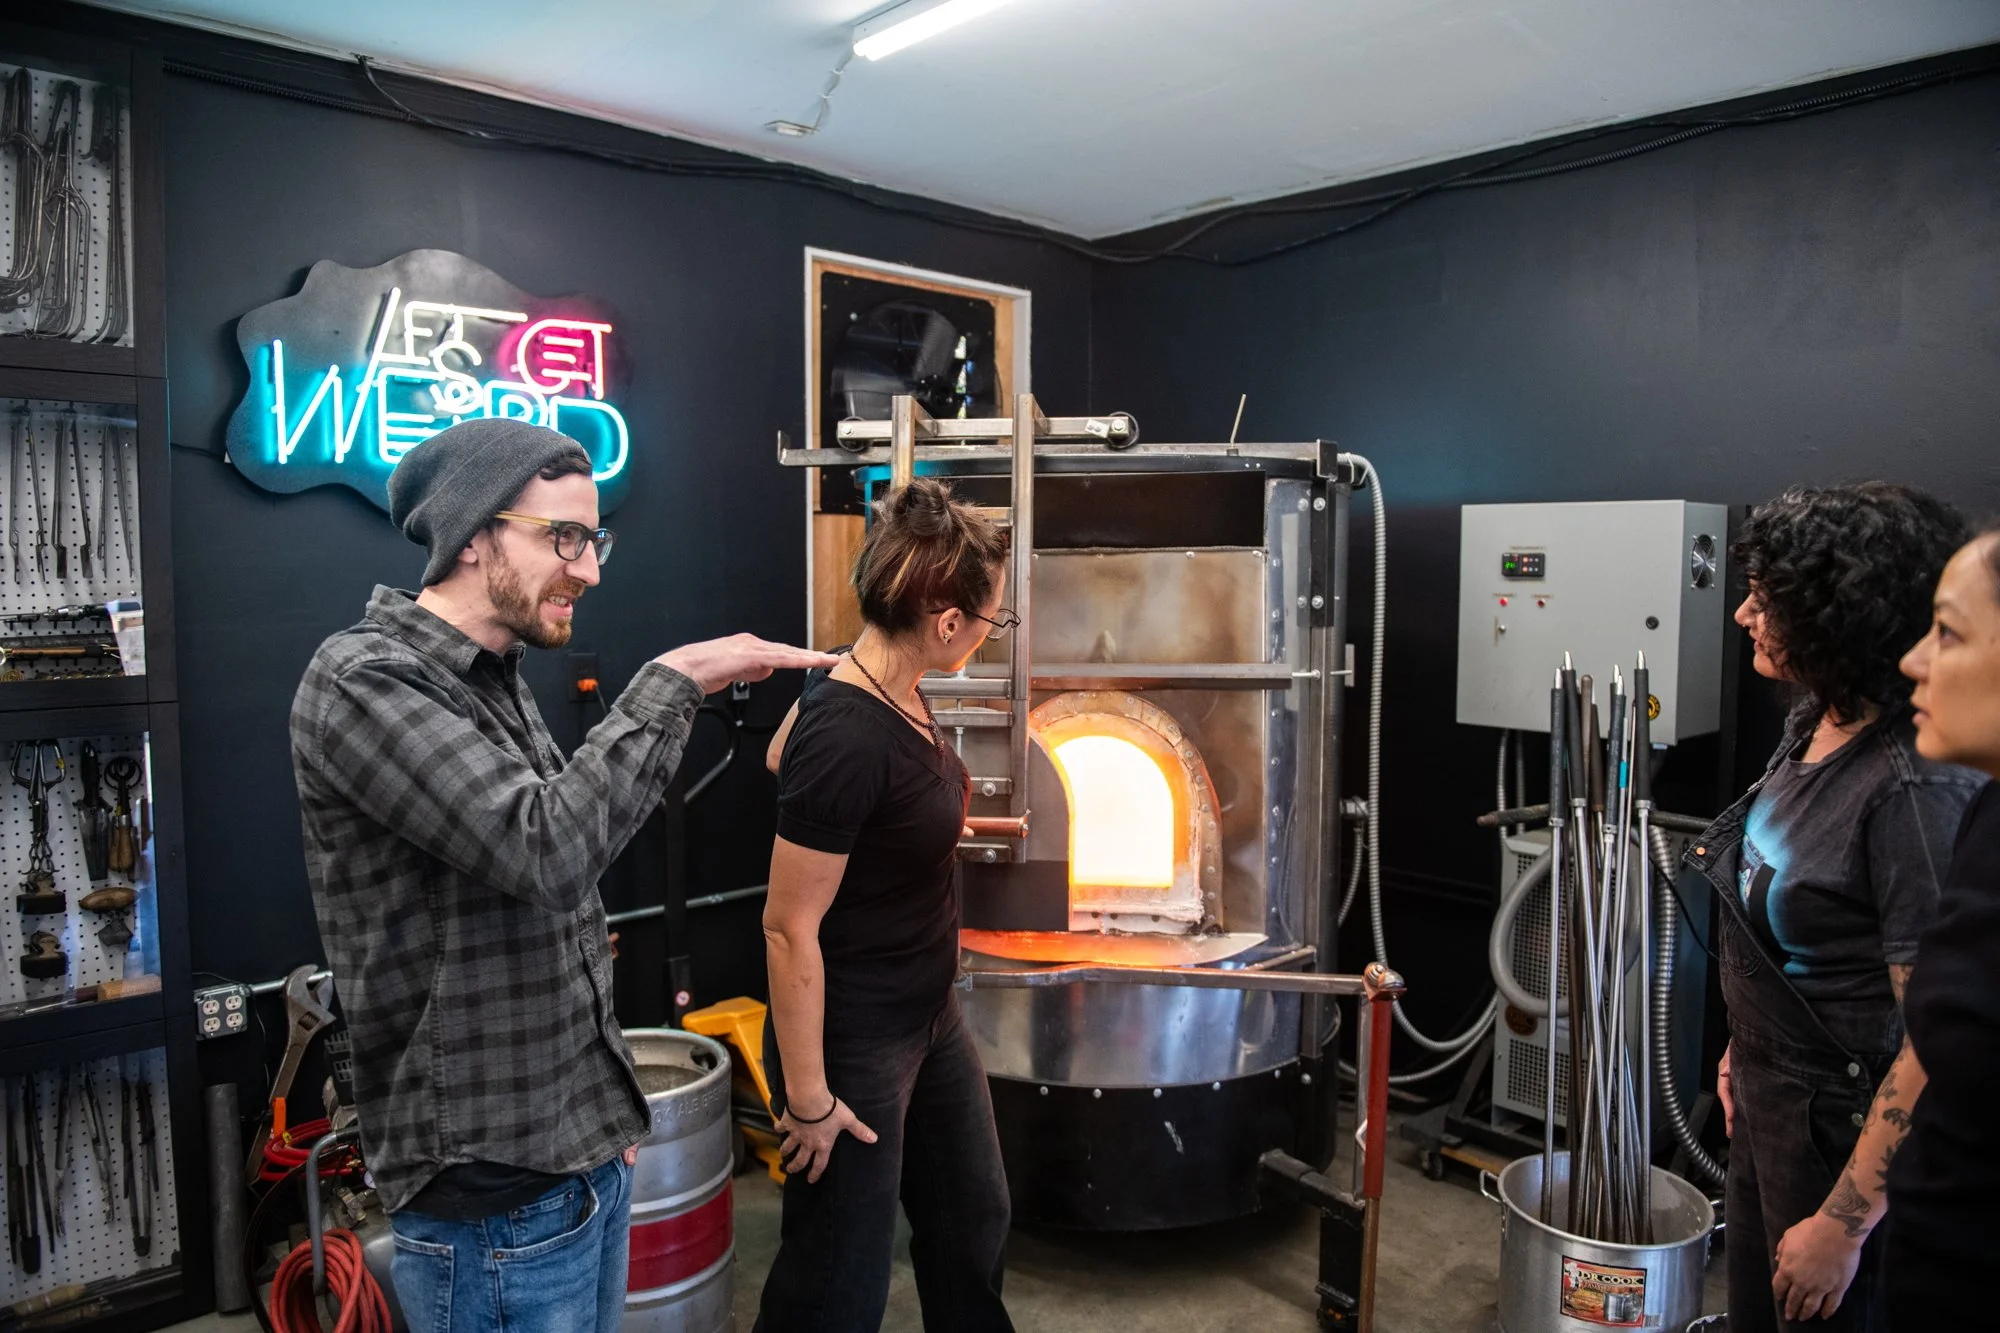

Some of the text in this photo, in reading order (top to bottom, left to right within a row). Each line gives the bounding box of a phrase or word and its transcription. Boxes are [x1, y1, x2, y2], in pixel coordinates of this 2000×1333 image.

[516, 317, 612, 400] GET
[273, 339, 629, 482] WERD
[1602, 1275, 1642, 1285] COOK
